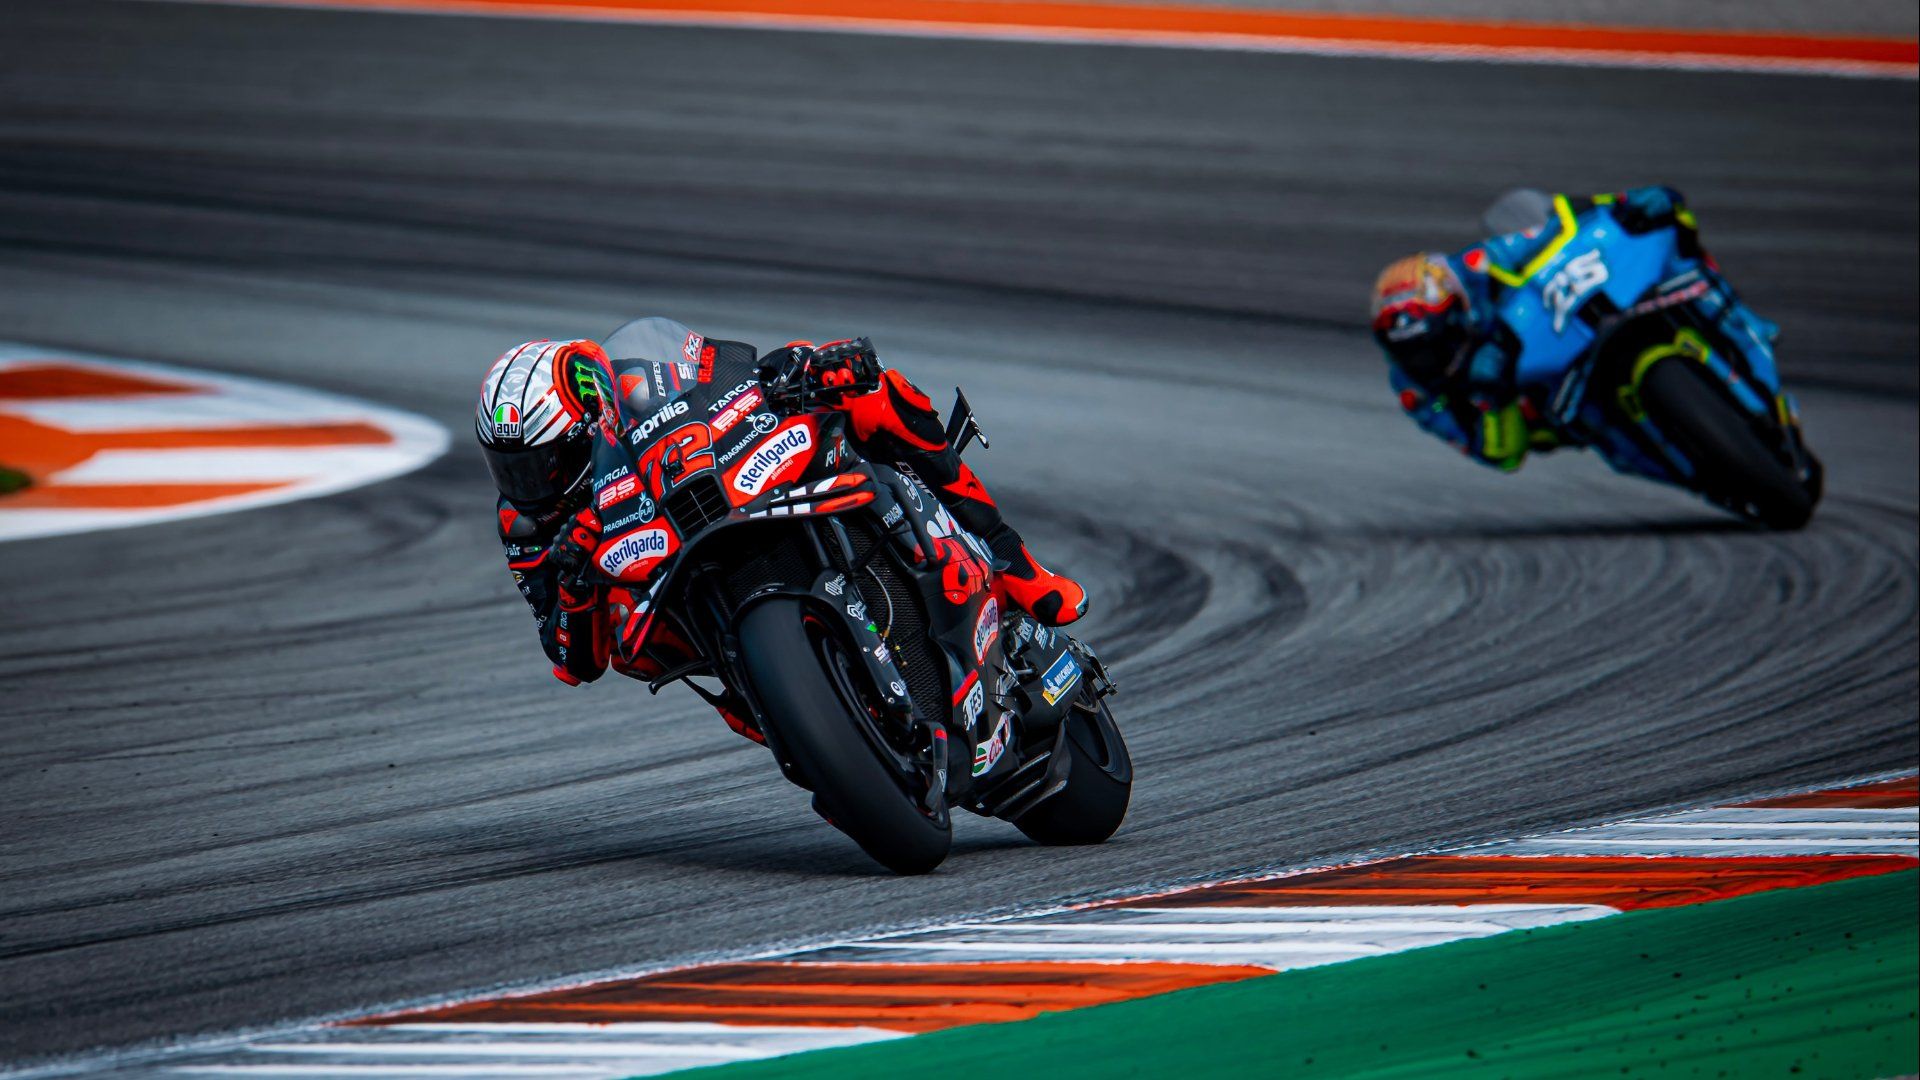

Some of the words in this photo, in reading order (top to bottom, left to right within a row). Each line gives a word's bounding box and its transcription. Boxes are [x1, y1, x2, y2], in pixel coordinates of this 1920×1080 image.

[708, 379, 759, 413] TARGA
[712, 391, 759, 430] BS
[496, 423, 518, 435] agv
[631, 401, 689, 446] aprilia
[718, 431, 759, 464] PRAGMATIC
[757, 415, 775, 431] PLAY
[594, 465, 628, 491] TARGA
[638, 422, 716, 505] 72
[740, 430, 806, 490] sterilgarda
[600, 477, 635, 505] BS
[603, 512, 640, 533] PRAGMATIC
[640, 506, 653, 518] PLAY
[604, 531, 664, 573] sterilgarda
[1054, 660, 1075, 686] MICHELIN
